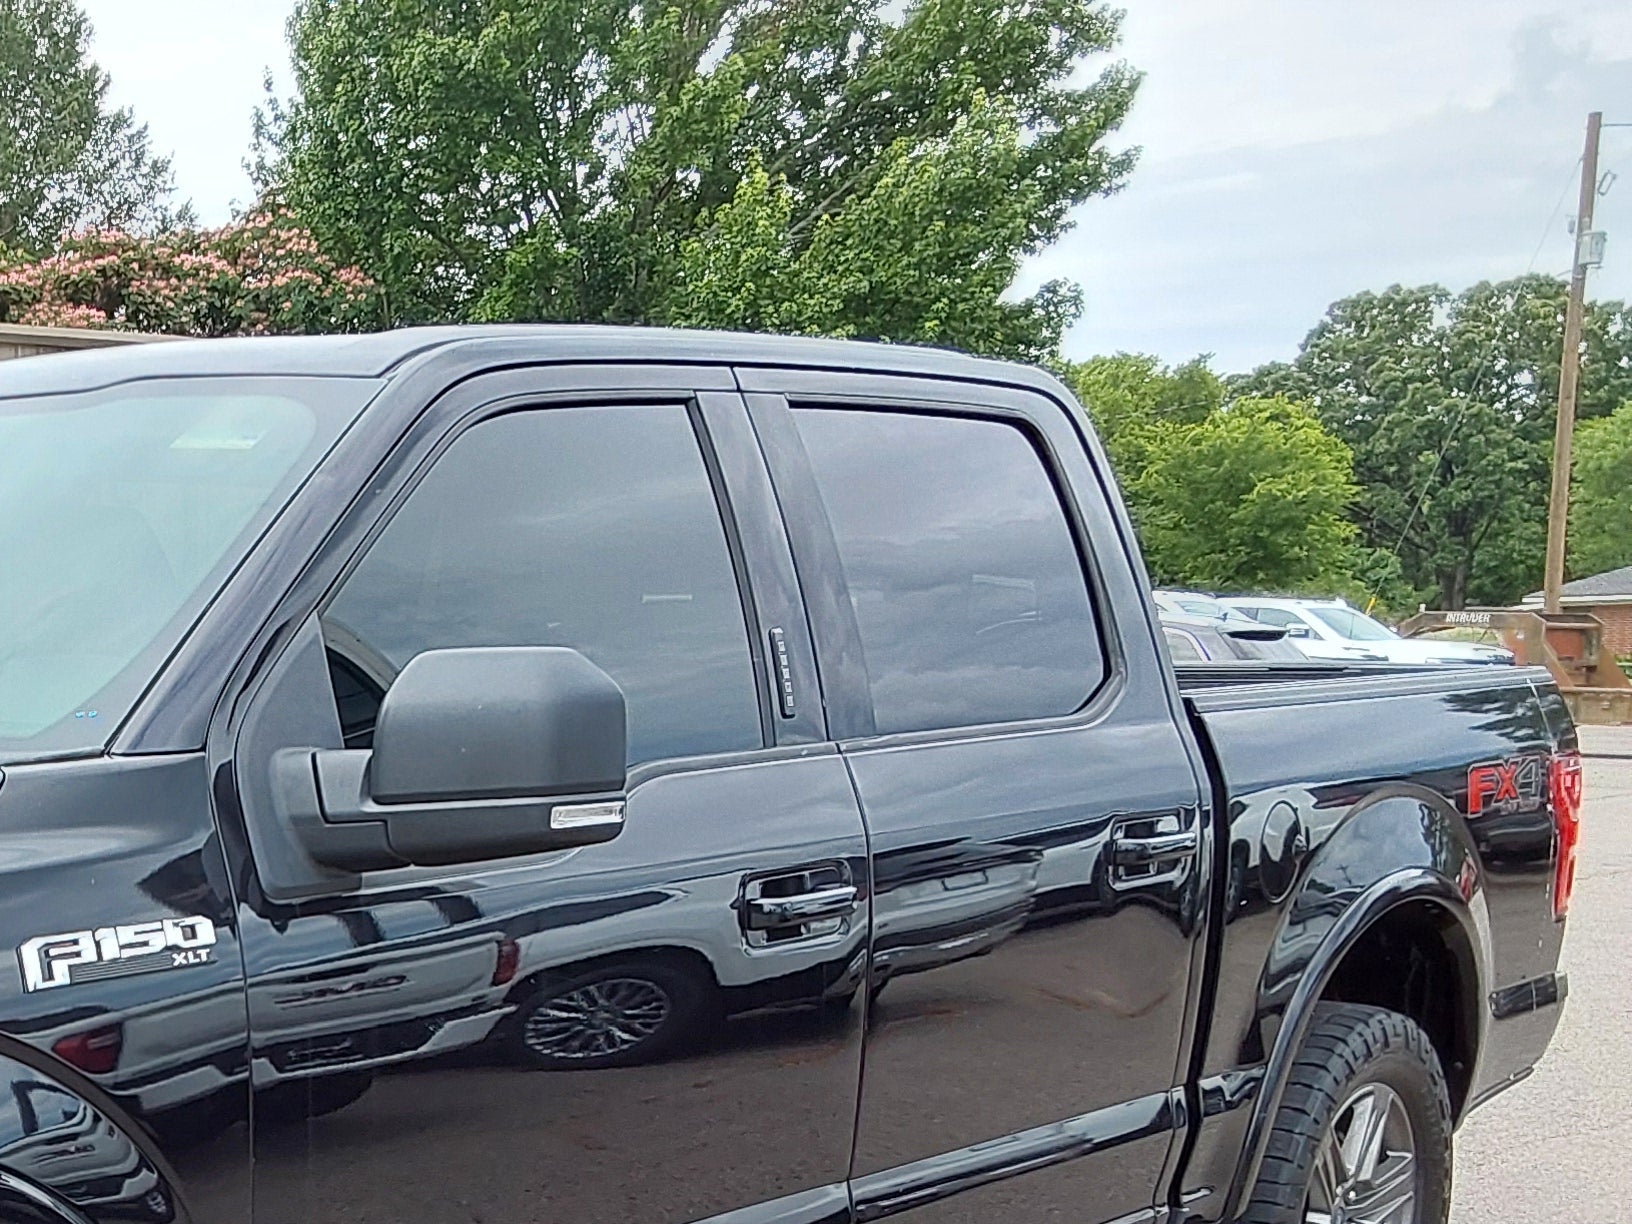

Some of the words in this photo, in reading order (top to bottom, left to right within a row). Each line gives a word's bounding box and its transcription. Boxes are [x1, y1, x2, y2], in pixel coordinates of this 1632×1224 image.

[1446, 612, 1491, 623] INTRUDER
[1468, 756, 1540, 818] FX4
[172, 949, 210, 967] XLT
